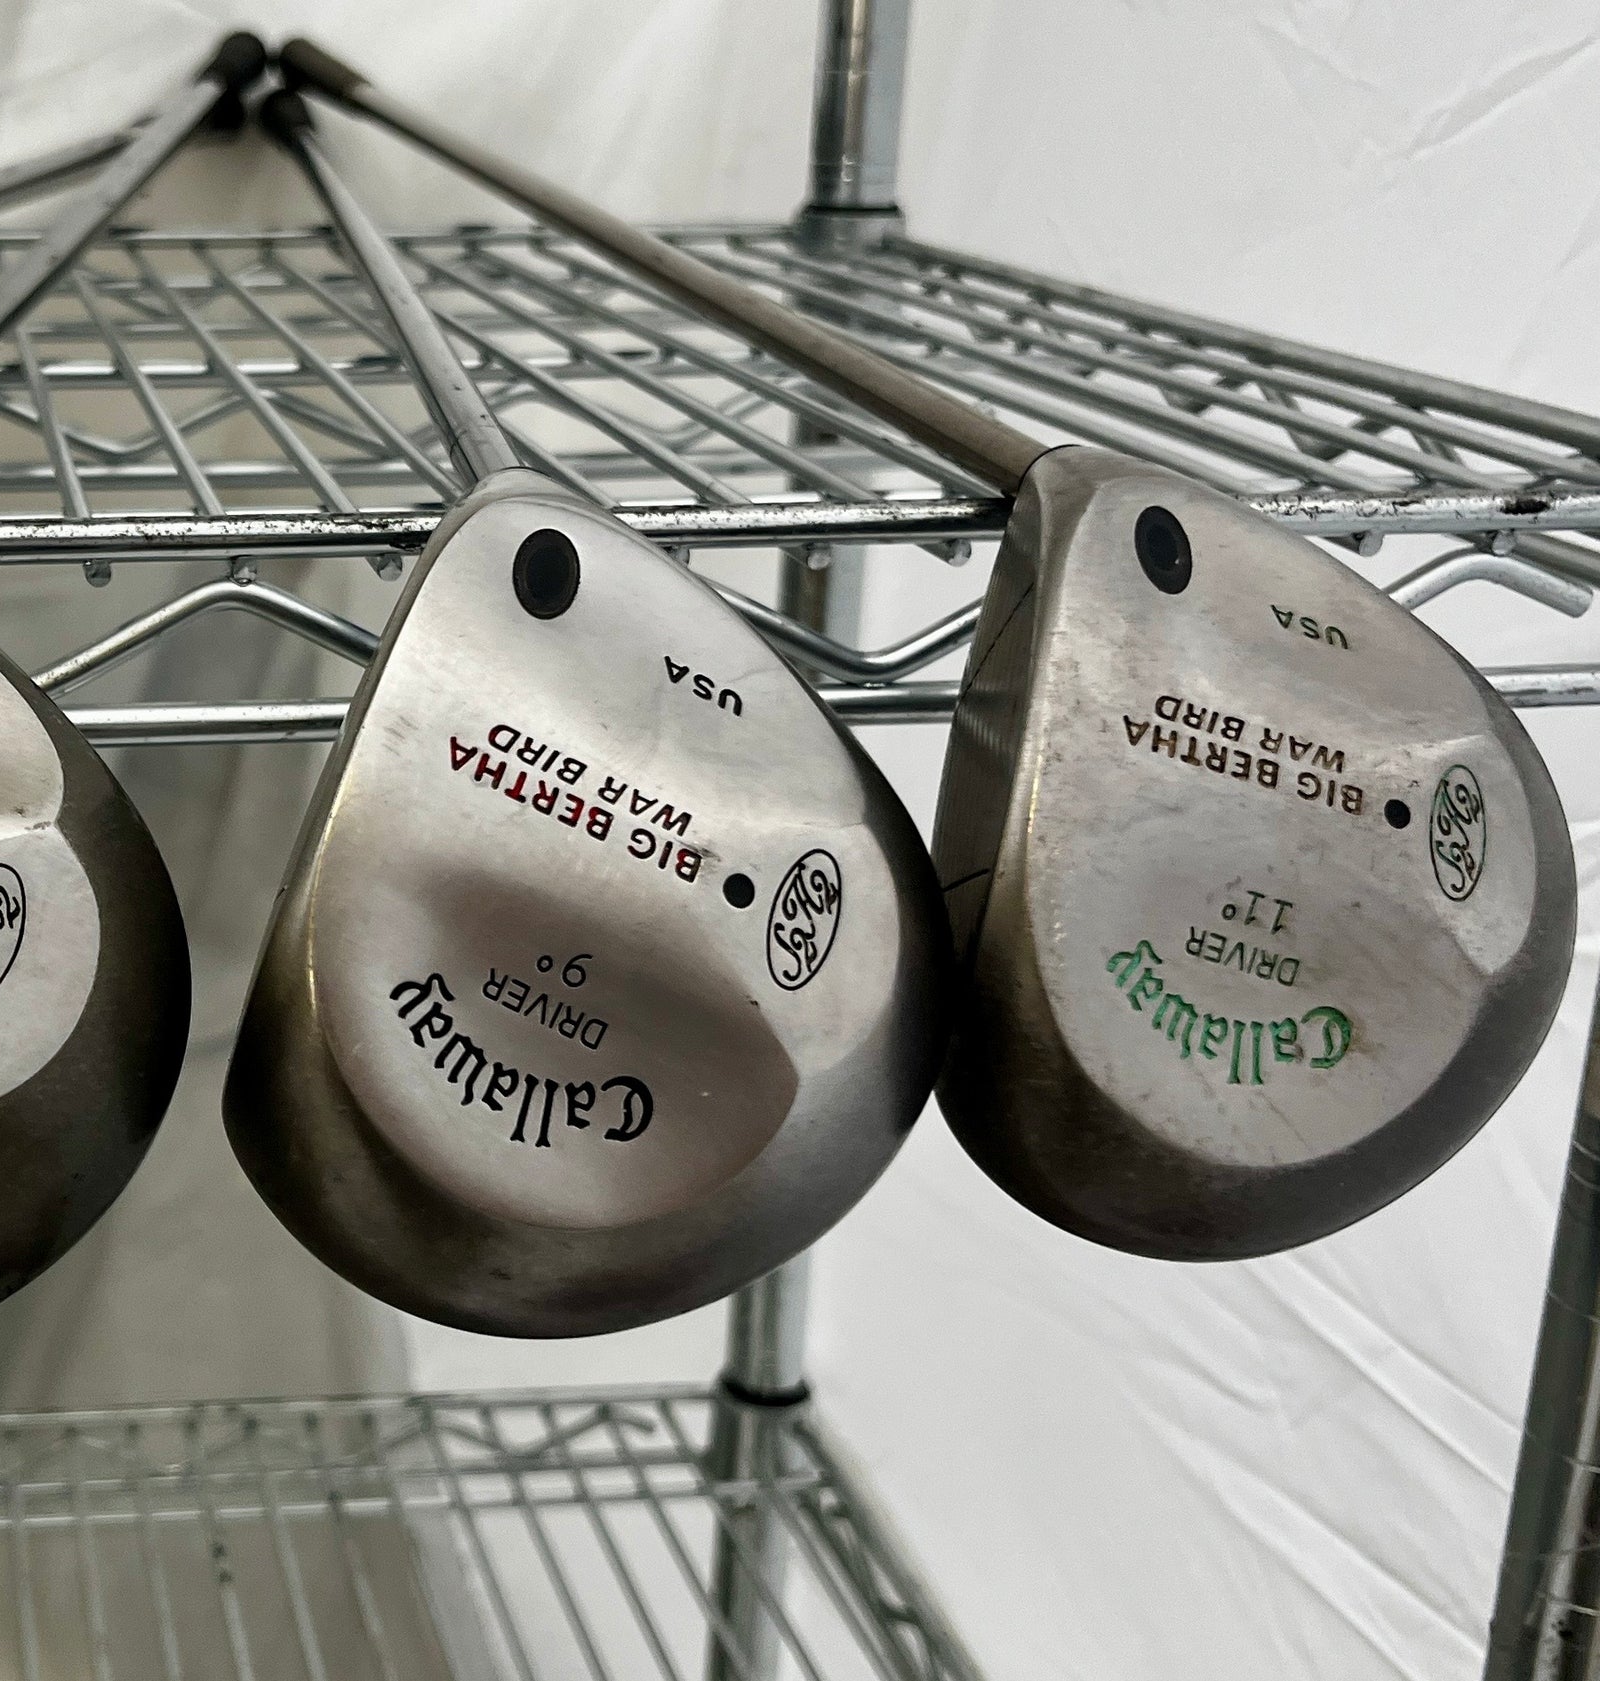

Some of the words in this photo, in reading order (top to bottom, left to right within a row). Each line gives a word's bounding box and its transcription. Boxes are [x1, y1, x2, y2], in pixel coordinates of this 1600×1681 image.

[1269, 604, 1350, 650] USA
[664, 655, 744, 717] USA
[1154, 694, 1246, 742] BIRD
[489, 724, 588, 784] BIRD
[1122, 714, 1280, 788] BERTHA
[1262, 725, 1345, 775] WAR
[449, 736, 613, 843] BERTHA
[597, 775, 693, 836] WAR
[1297, 772, 1364, 815] BIG
[626, 828, 702, 884] BIG
[1185, 926, 1300, 988] DRIVER
[480, 967, 610, 1051] DRIVER
[1106, 938, 1353, 1086] Callaway
[389, 972, 655, 1148] Callaway
